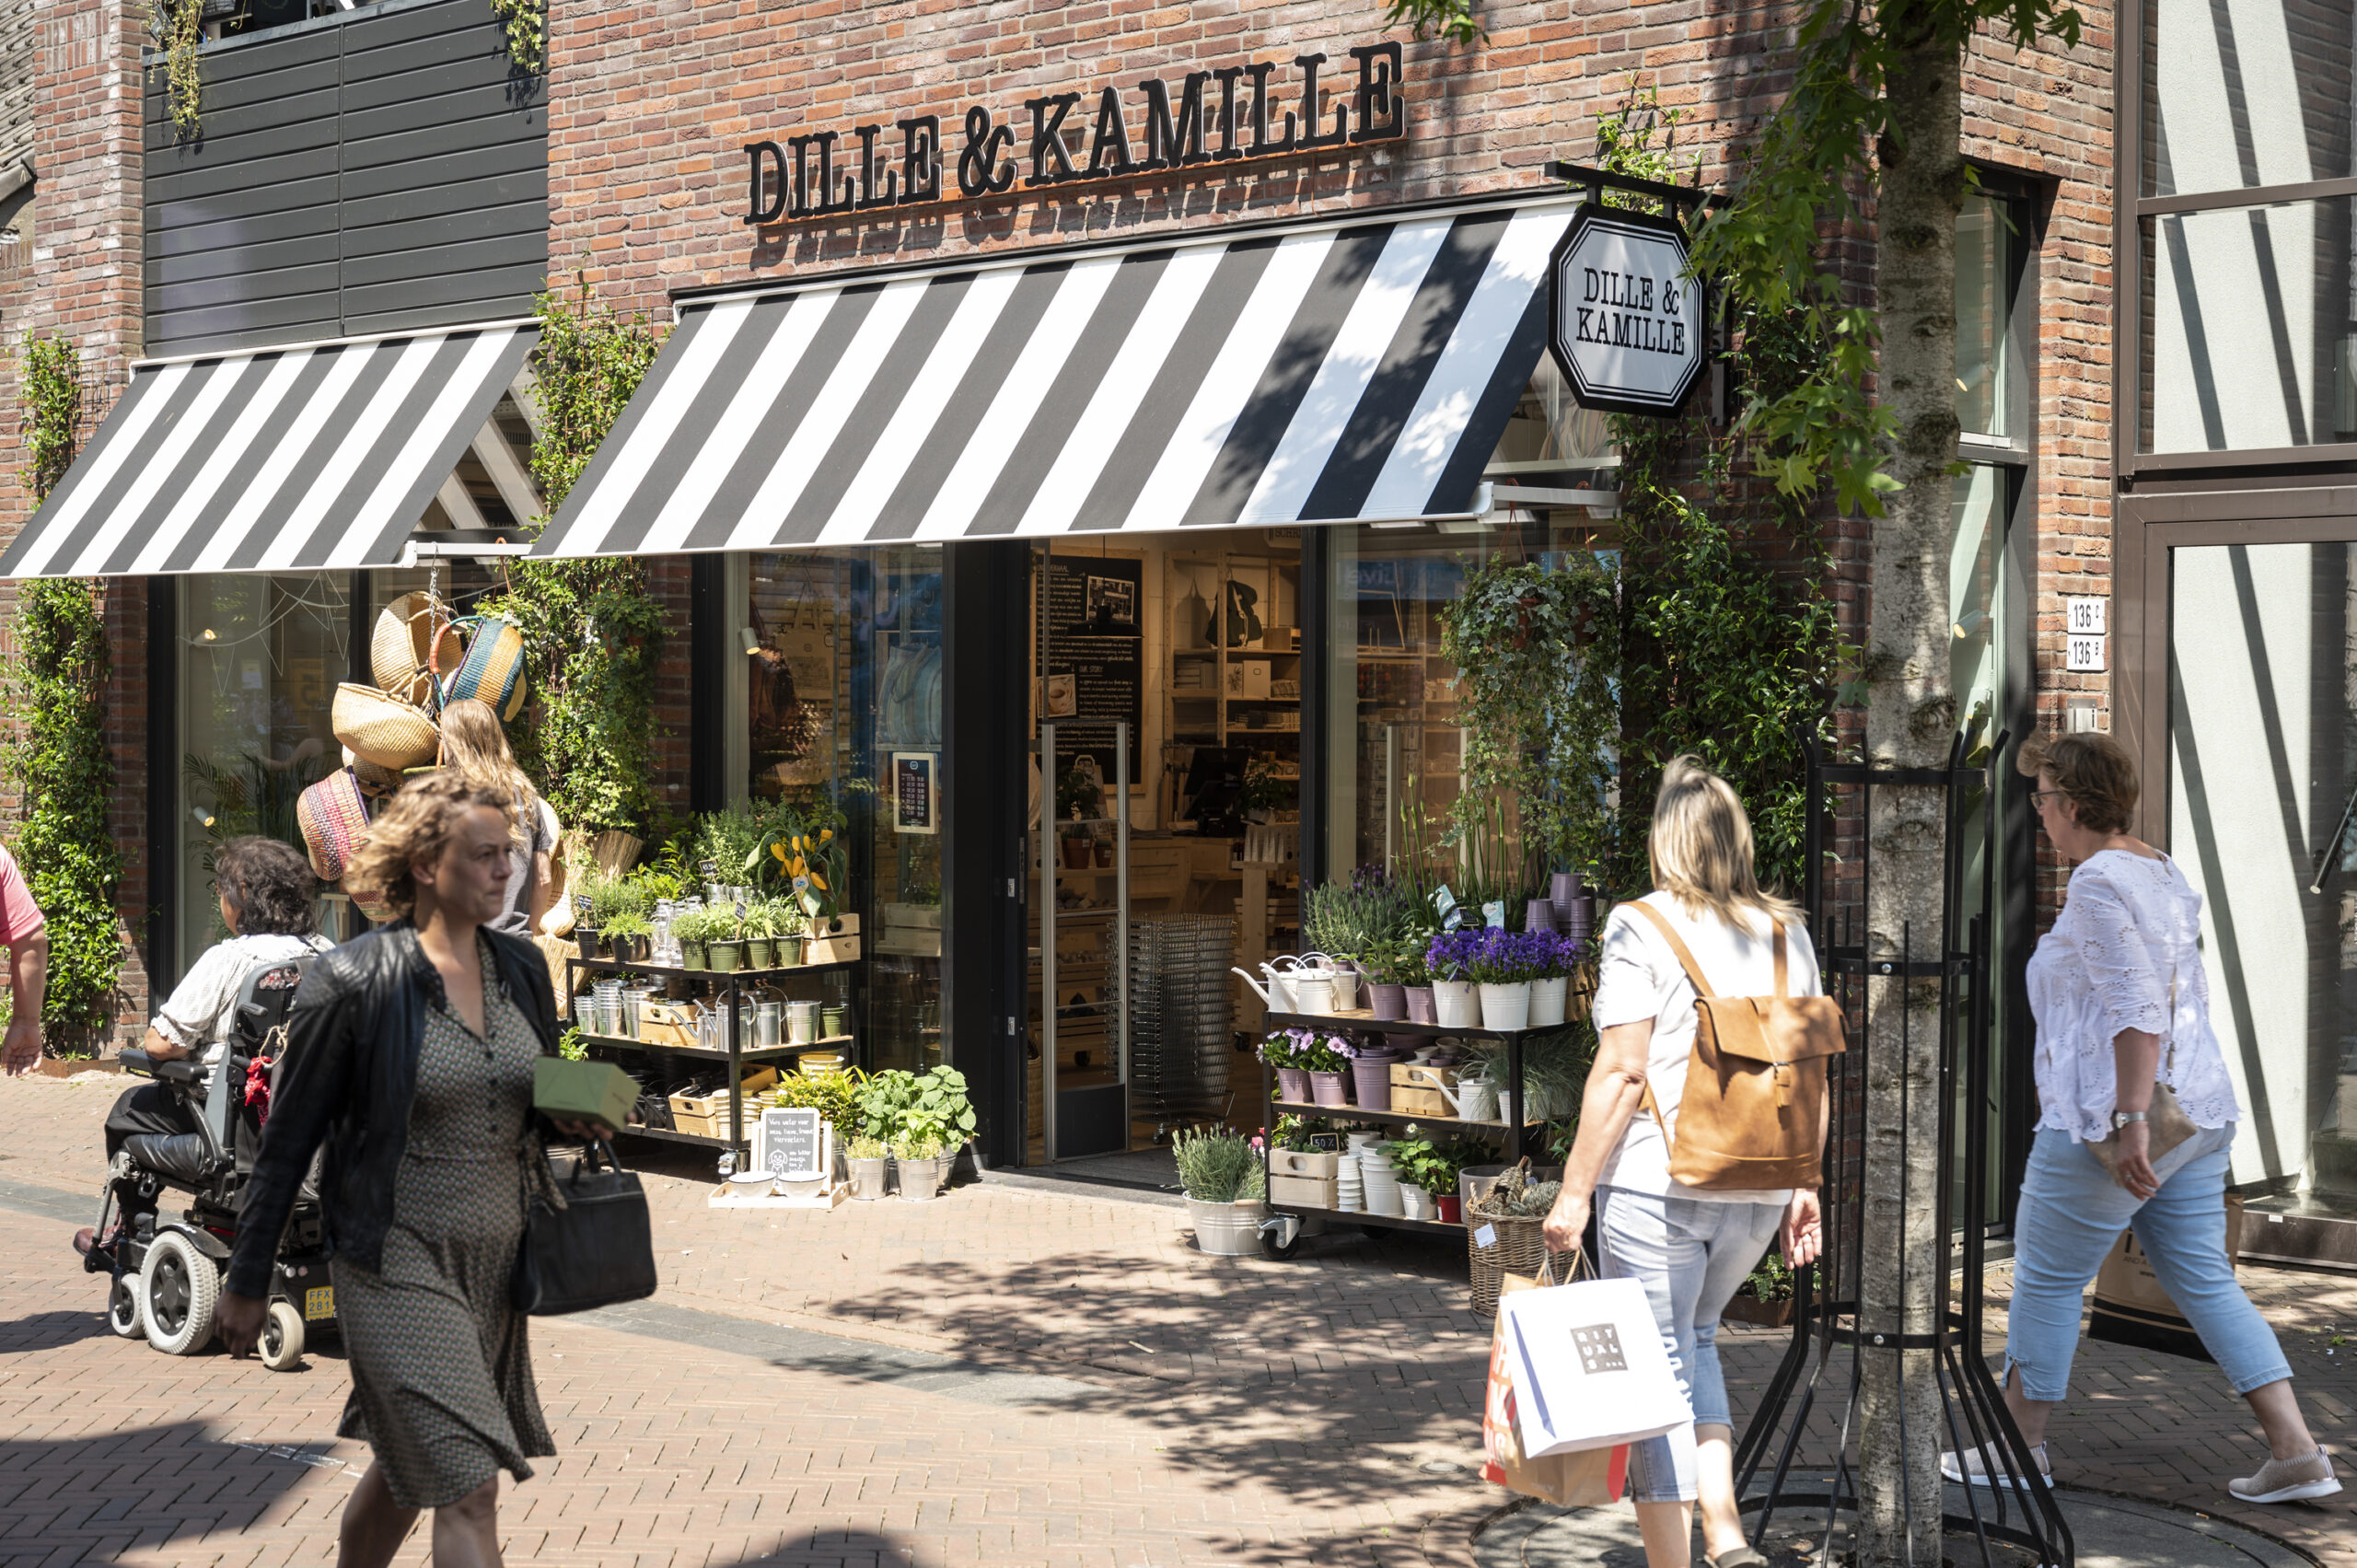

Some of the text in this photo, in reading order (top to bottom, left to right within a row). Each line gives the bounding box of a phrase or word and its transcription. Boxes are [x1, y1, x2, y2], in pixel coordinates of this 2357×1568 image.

[744, 41, 1404, 224] DILLE & KAMILLE
[1584, 267, 1679, 315] DILLE &
[1576, 307, 1684, 355] KAMILLE
[2074, 604, 2091, 628] 136
[2073, 641, 2090, 665] 136
[308, 1301, 330, 1312] 281
[309, 1289, 331, 1301] FFX
